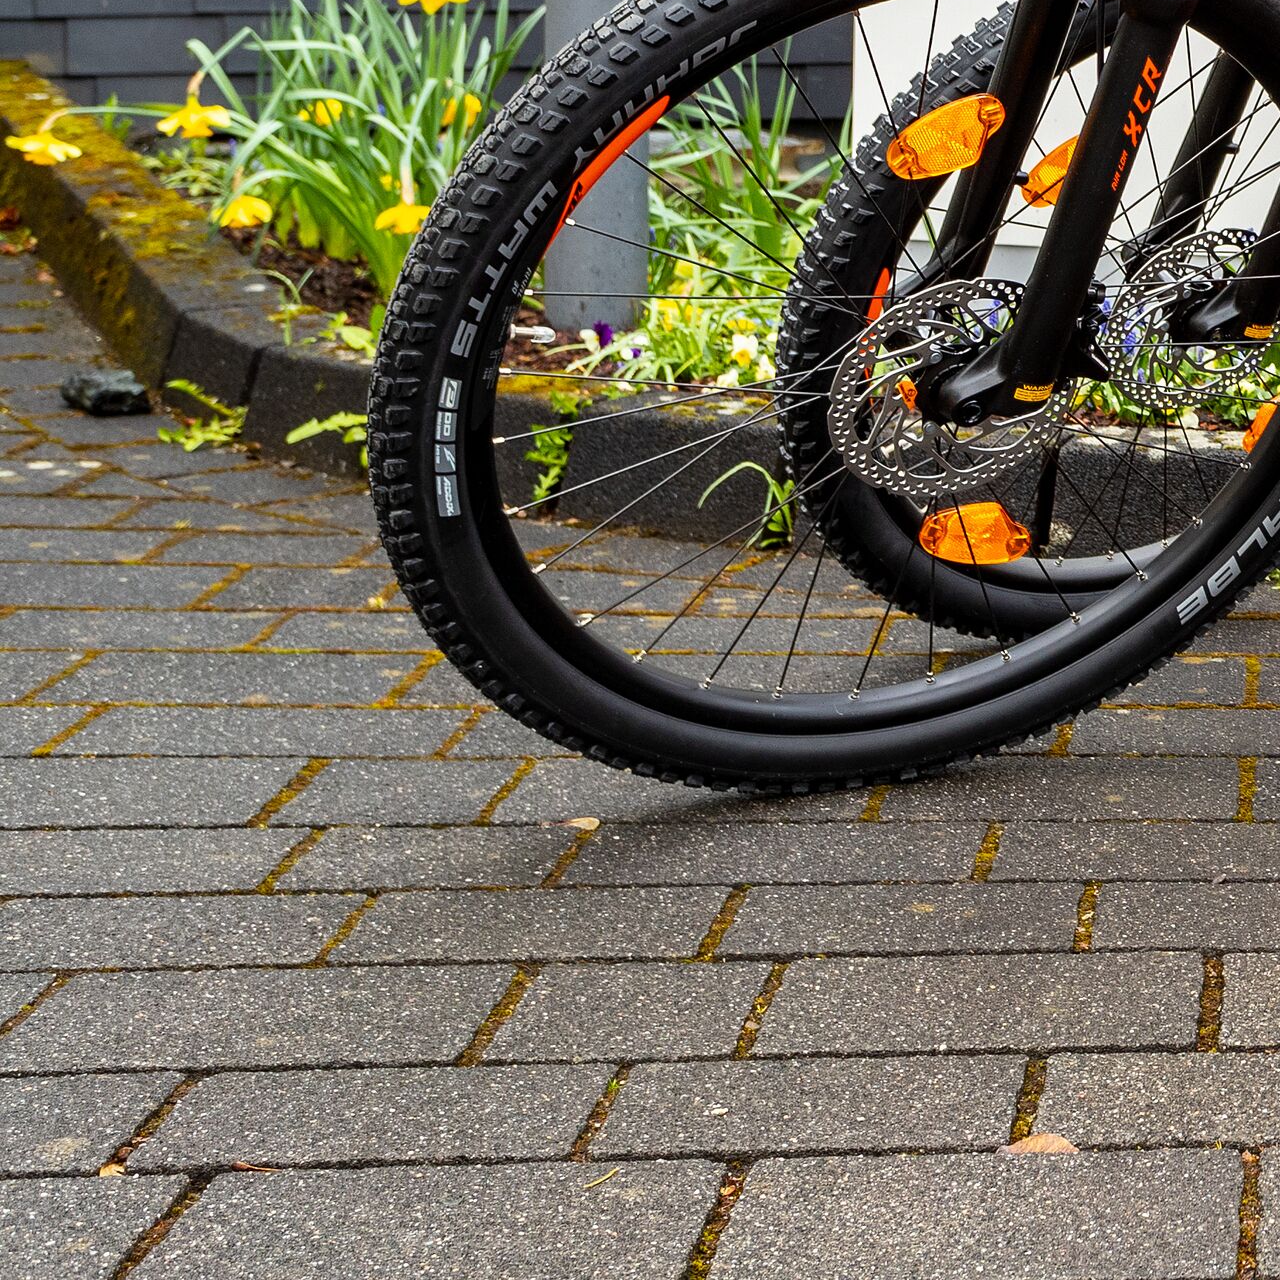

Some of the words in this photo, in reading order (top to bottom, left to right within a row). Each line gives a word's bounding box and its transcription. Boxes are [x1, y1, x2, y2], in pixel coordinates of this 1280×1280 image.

[573, 19, 758, 173] JOHNNY
[1123, 55, 1162, 148] XCR
[451, 180, 558, 358] WATTS
